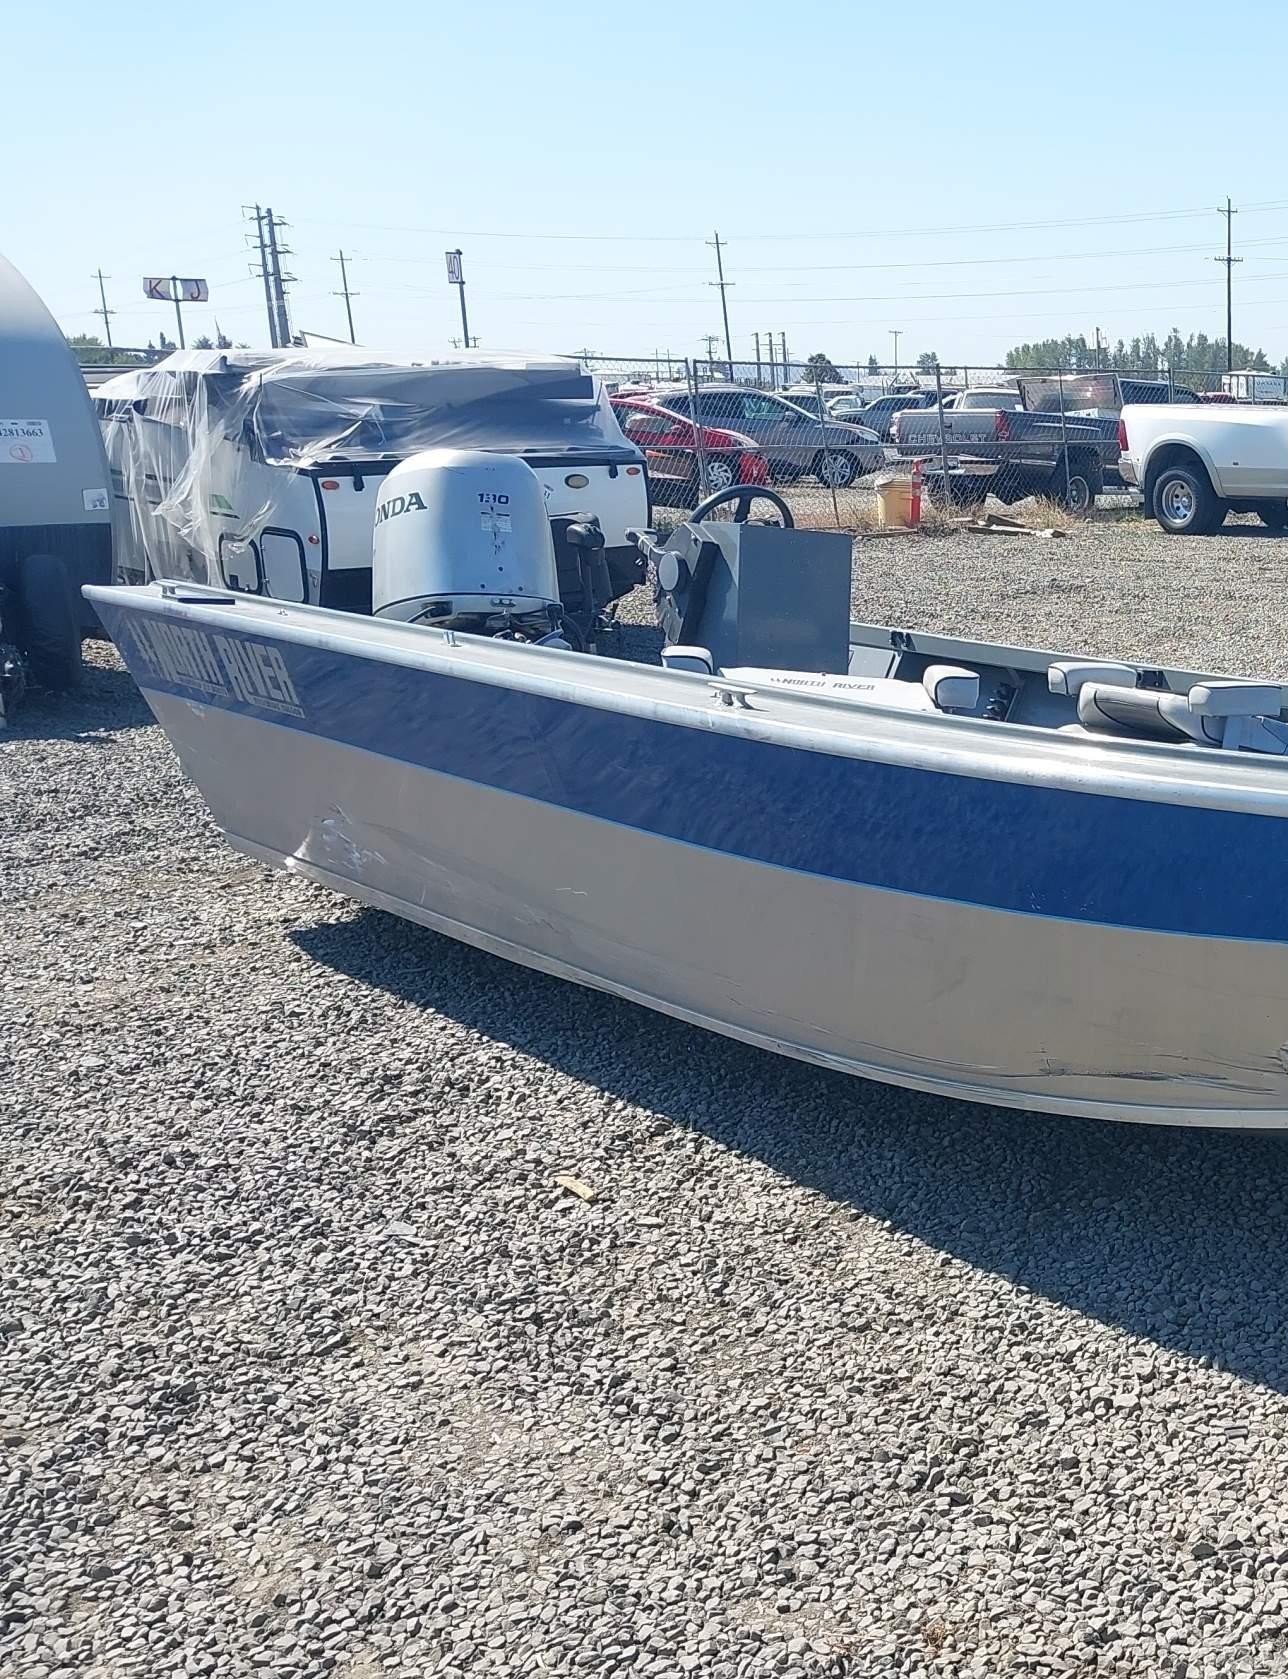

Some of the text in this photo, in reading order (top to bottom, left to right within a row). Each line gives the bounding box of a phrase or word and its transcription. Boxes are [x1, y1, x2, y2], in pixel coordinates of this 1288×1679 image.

[149, 279, 166, 299] K
[190, 280, 201, 300] J
[374, 491, 428, 528] NDA
[212, 633, 301, 706] RIVER
[832, 682, 876, 691] RIVER
